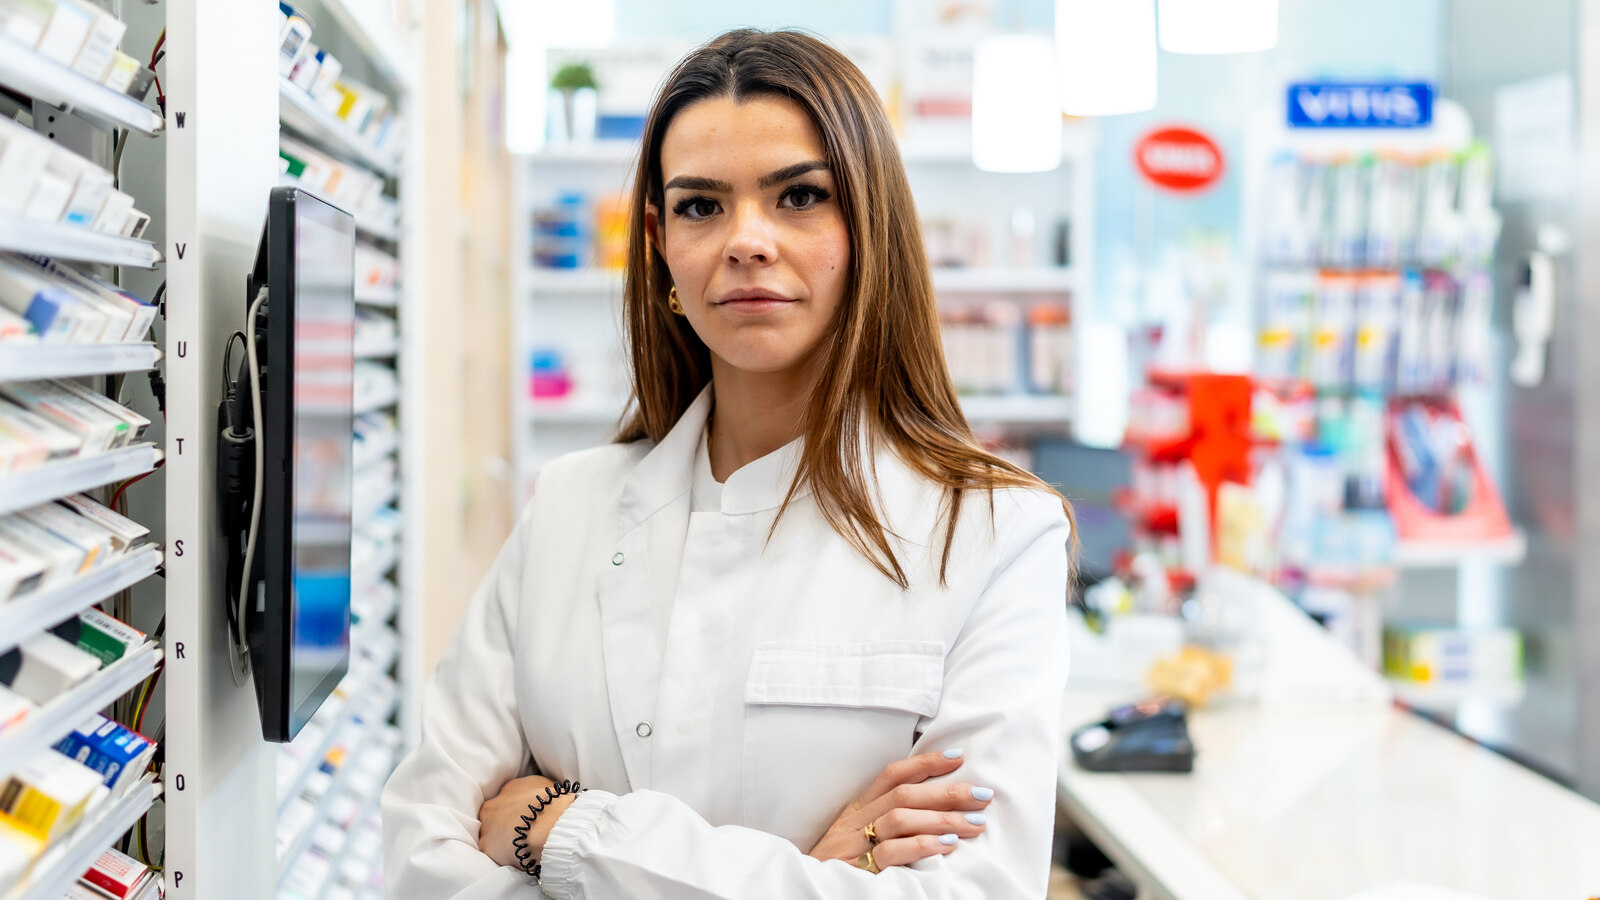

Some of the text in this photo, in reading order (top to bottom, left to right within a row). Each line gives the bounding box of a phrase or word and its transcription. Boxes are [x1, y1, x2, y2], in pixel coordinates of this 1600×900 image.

[175, 111, 186, 129] W
[175, 242, 187, 260] V
[177, 340, 187, 359] U
[175, 437, 185, 456] T
[174, 539, 184, 558] S
[175, 641, 186, 660] R
[173, 870, 184, 889] P
